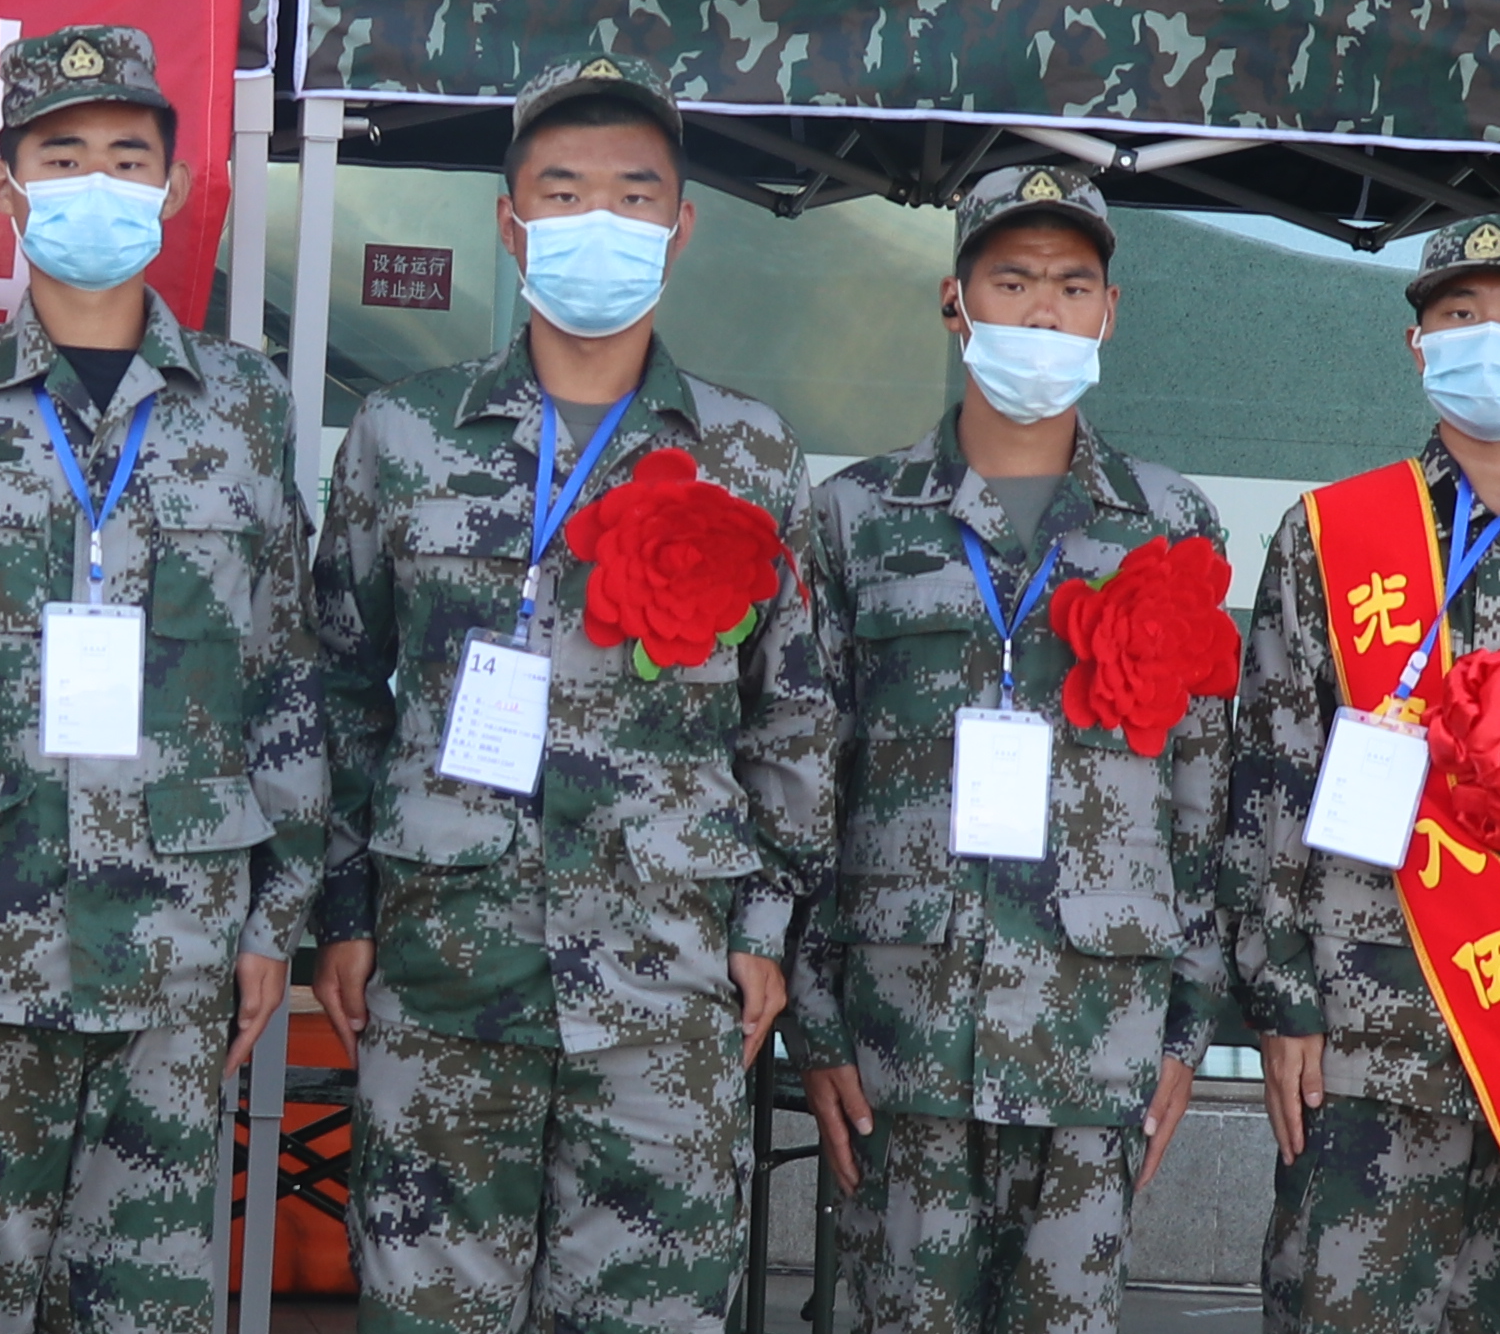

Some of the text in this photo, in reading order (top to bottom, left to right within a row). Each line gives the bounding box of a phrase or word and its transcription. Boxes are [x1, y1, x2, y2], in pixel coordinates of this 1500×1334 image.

[371, 254, 446, 276] 设备运行
[369, 279, 445, 301] 禁止进入
[469, 653, 497, 676] 14
